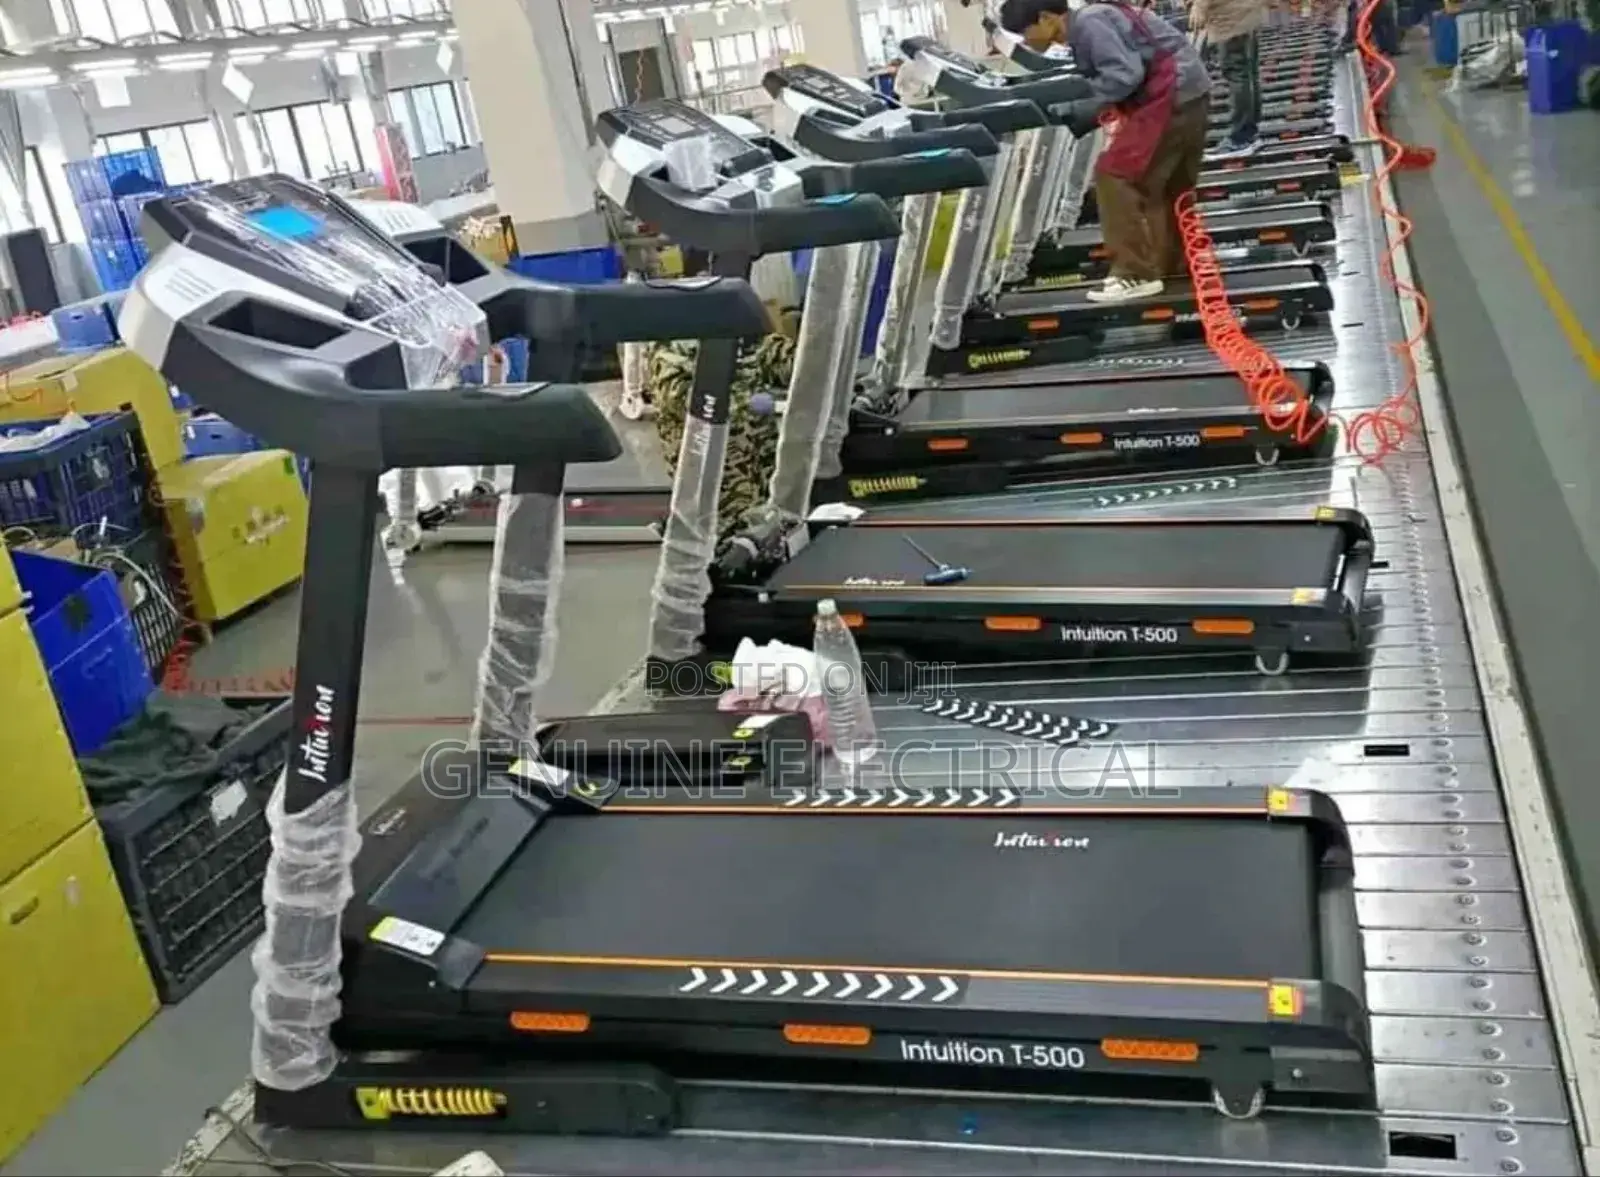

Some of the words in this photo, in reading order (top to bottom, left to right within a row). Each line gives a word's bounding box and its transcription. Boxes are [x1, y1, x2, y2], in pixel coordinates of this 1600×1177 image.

[1164, 434, 1201, 447] T-500
[1060, 625, 1127, 642] Intuition
[1131, 626, 1178, 643] T-500
[900, 1039, 1004, 1065] Intuition
[1010, 1043, 1085, 1069] T-500
